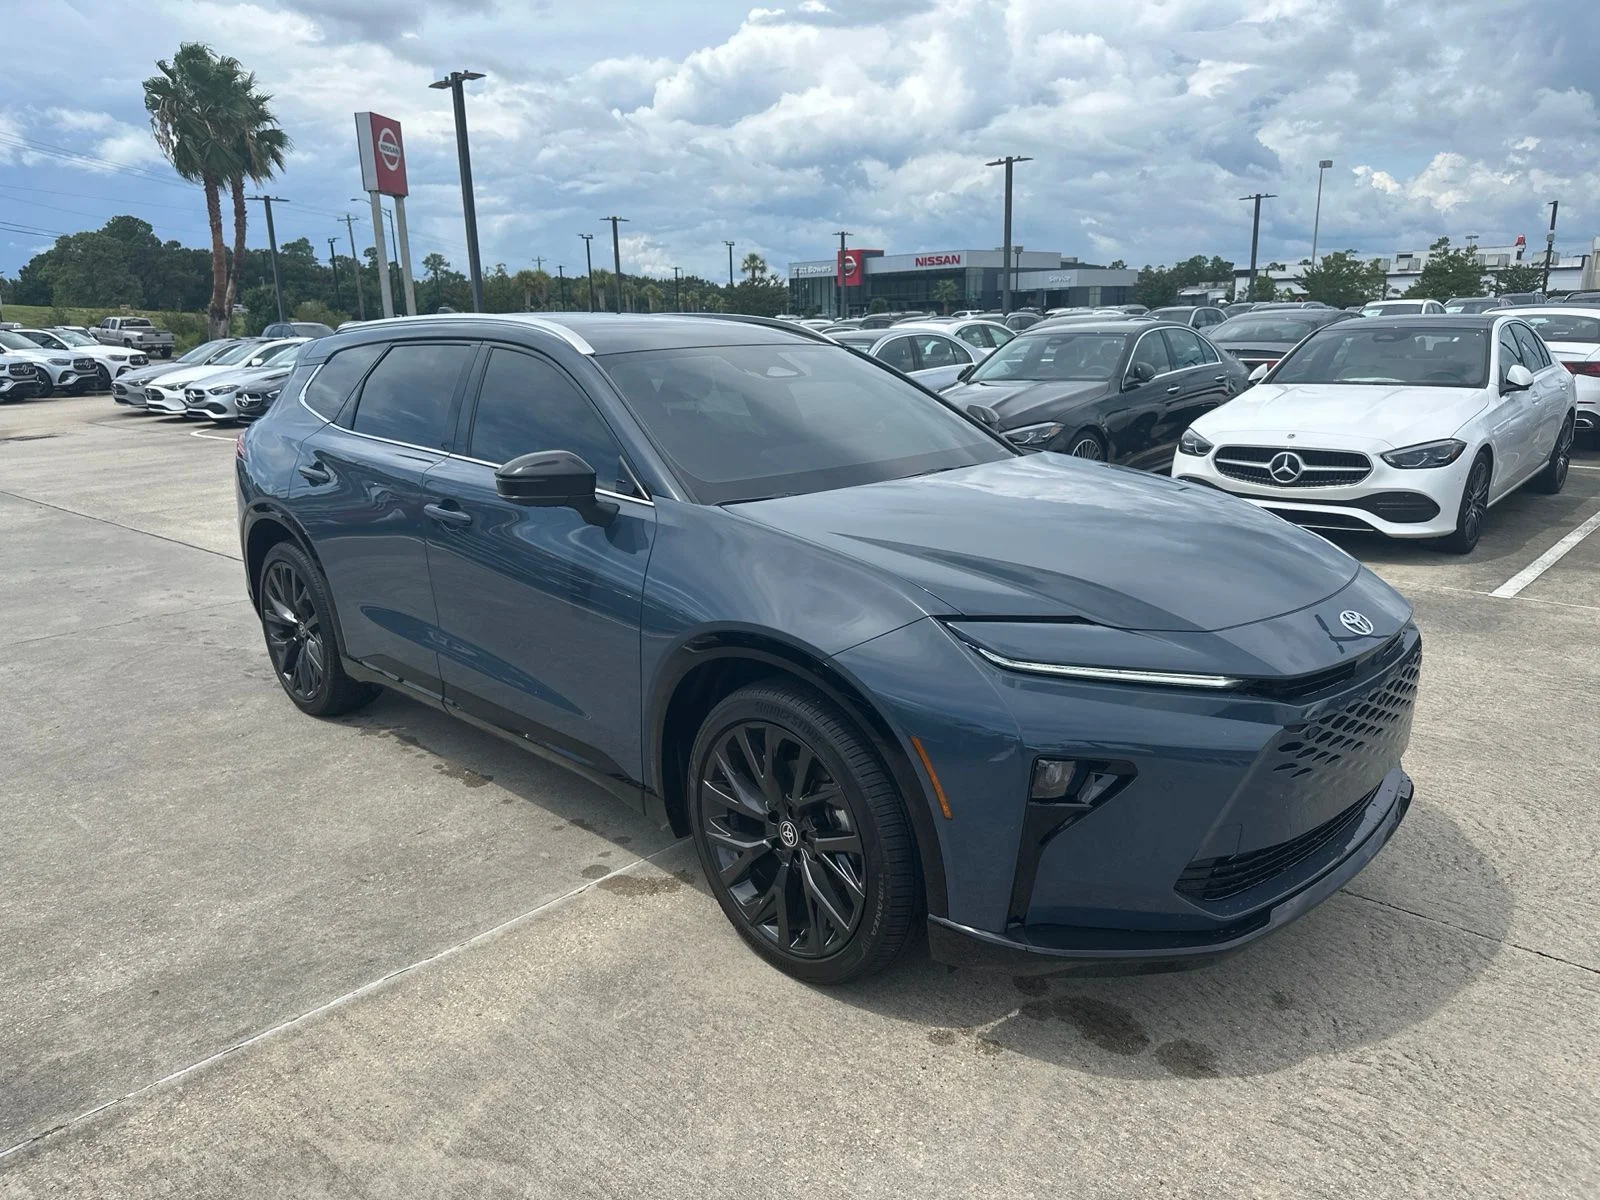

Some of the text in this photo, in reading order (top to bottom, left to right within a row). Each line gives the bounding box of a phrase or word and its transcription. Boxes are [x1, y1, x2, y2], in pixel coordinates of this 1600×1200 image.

[380, 143, 400, 154] NISSAN
[915, 254, 961, 267] NISSAN
[869, 872, 884, 937] TURANZA
